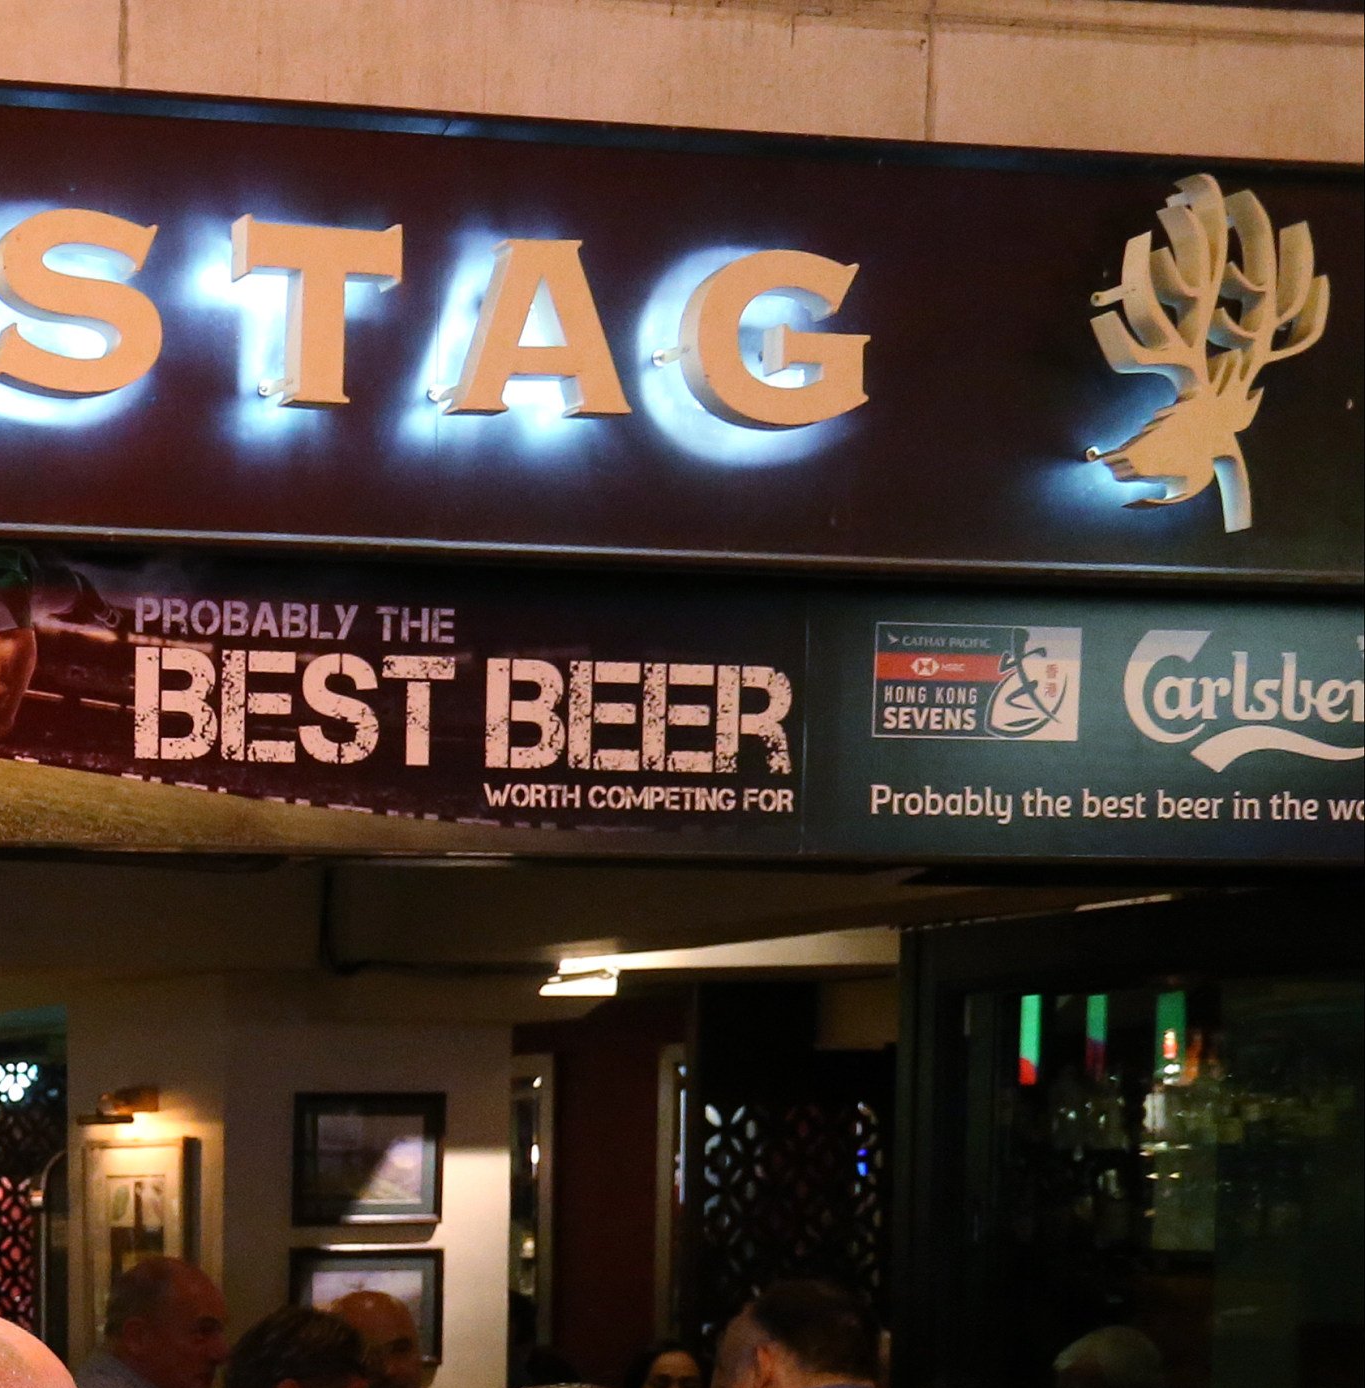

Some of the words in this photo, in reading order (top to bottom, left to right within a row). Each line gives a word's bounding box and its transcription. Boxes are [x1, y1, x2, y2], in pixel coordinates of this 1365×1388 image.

[134, 597, 360, 640] PROBABLY
[375, 605, 456, 643] THE
[902, 635, 947, 648] CATHAY
[949, 637, 991, 649] PACIFIC
[883, 685, 927, 704] HONG
[935, 687, 978, 704] KONG
[134, 647, 456, 767] BEST
[484, 657, 793, 775] BEER
[883, 707, 976, 731] SEVENS
[483, 782, 580, 808] WORTH
[588, 785, 736, 811] COMPETING
[742, 788, 794, 813] FOR
[870, 784, 1013, 824] Probably
[1022, 787, 1071, 818] the
[1082, 788, 1146, 819] best
[1157, 789, 1223, 820] beer
[1232, 791, 1261, 820] in
[1269, 791, 1319, 821] the
